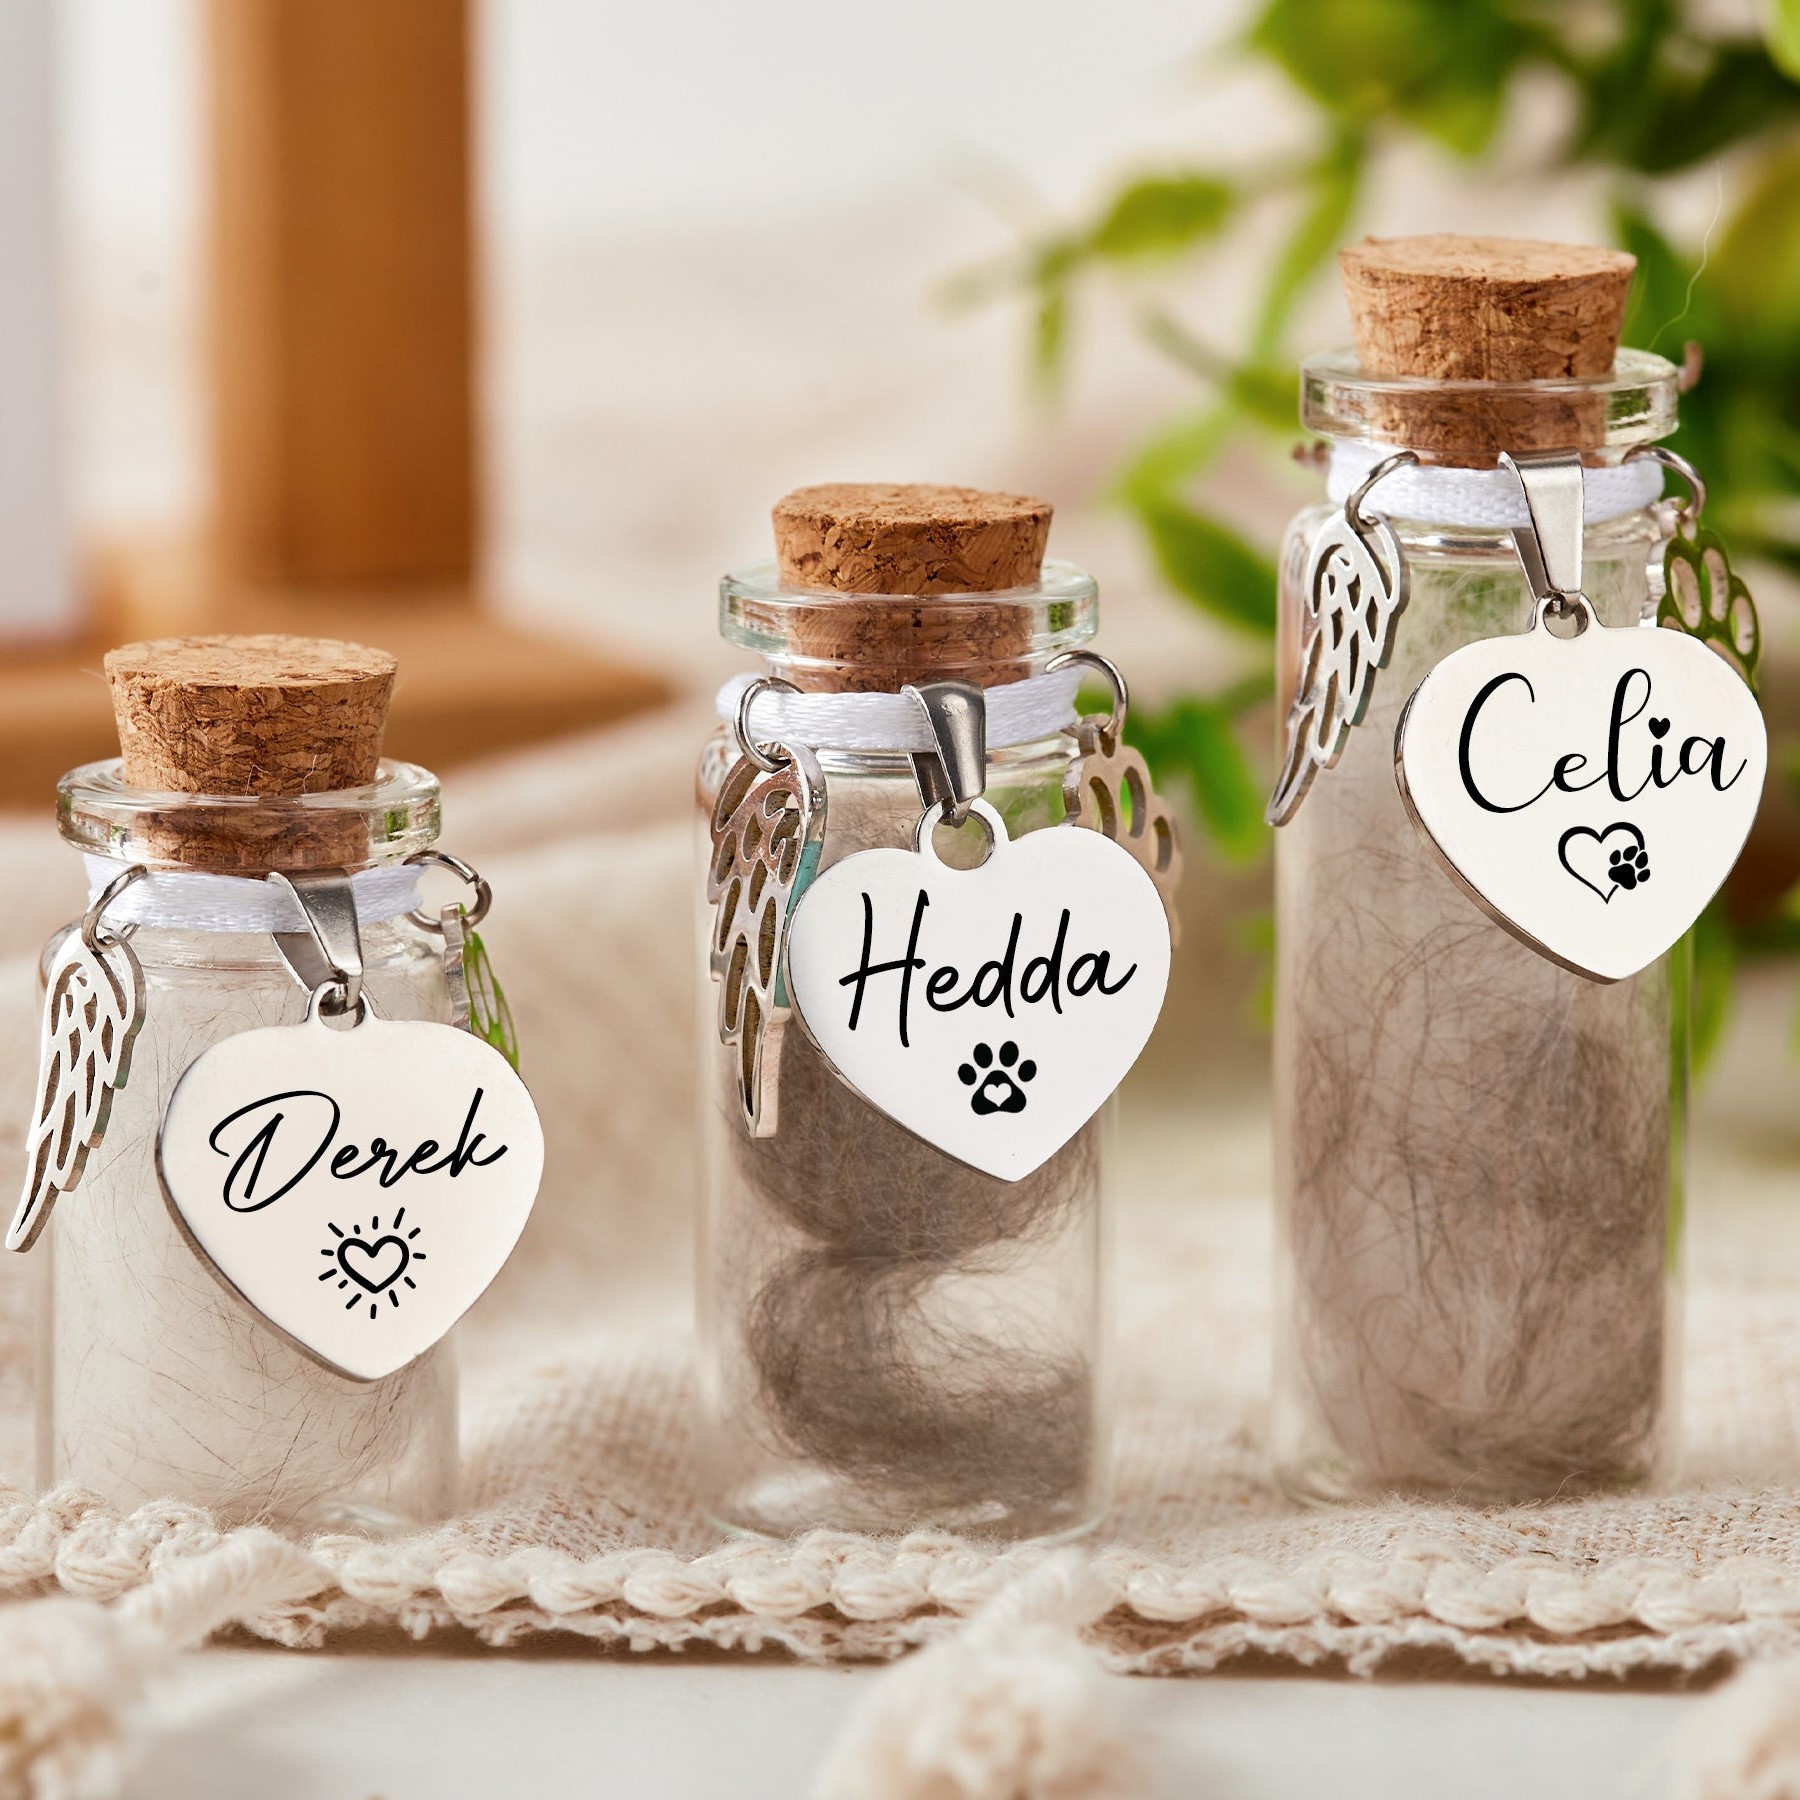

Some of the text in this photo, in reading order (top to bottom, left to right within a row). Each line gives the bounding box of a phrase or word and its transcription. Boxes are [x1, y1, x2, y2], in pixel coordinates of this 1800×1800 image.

[1458, 668, 1748, 814] Celia
[838, 889, 1138, 1048] Hedda
[208, 1087, 509, 1213] Derek
